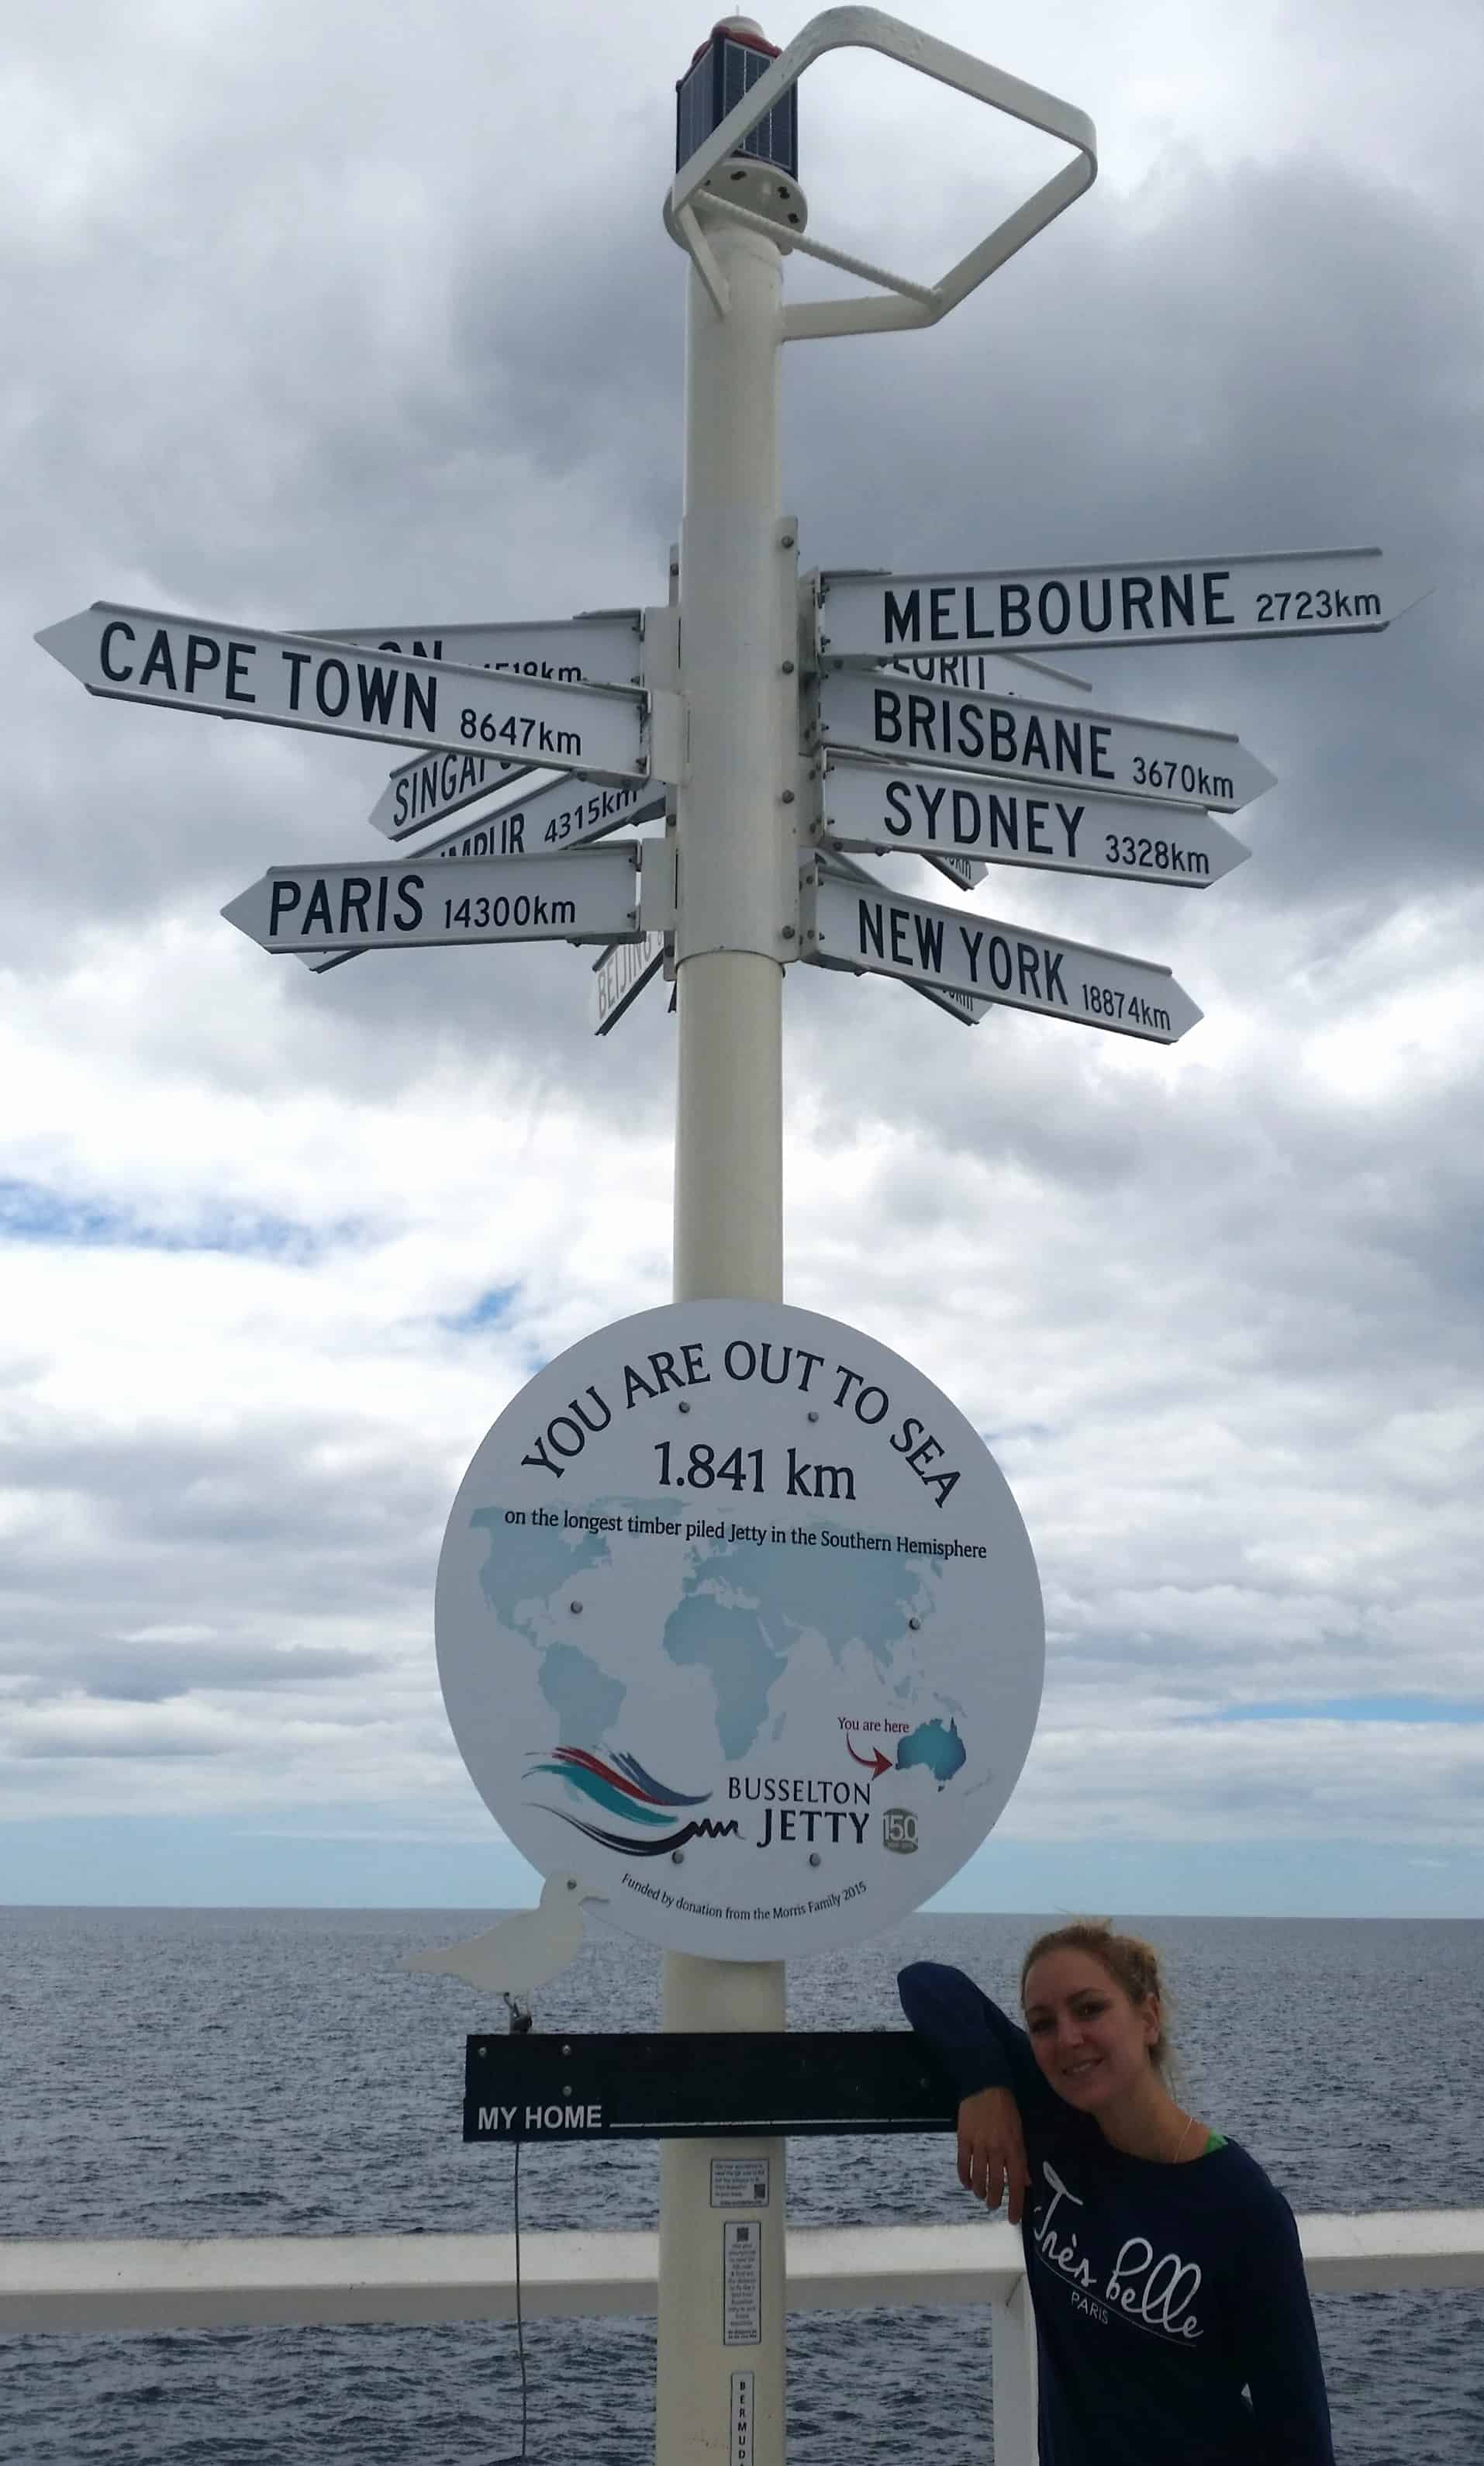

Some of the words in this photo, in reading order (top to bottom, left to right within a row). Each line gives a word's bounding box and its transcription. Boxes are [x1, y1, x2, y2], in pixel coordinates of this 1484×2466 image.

[884, 572, 1235, 644] MELBOURNE
[1255, 592, 1381, 622] 2723km
[99, 621, 257, 701] CAPE
[281, 651, 437, 733] TOWN
[459, 710, 582, 756] 8647km
[873, 689, 1115, 779] BRISBANE
[1132, 758, 1234, 800] 3670km
[884, 781, 1085, 858] SYDNEY
[1105, 836, 1210, 874] 3328km
[269, 874, 425, 935] PARIS
[443, 897, 576, 928] 14300km
[858, 900, 944, 973] NEW
[958, 927, 1069, 1005] YORK
[1082, 984, 1171, 1031] 18874km
[521, 1387, 611, 1477] YOU
[623, 1343, 710, 1408] ARE
[724, 1340, 824, 1391] OUT
[833, 1366, 889, 1425] TO
[889, 1418, 961, 1508] SEA
[654, 1441, 765, 1492] 1.841
[786, 1449, 855, 1500] km
[505, 1510, 526, 1525] on
[531, 1508, 558, 1526] the
[563, 1509, 622, 1533] longest
[627, 1513, 682, 1536] timber
[685, 1519, 725, 1541] piled
[728, 1522, 767, 1546] Jetty
[771, 1525, 786, 1543] in
[791, 1528, 817, 1546] the
[821, 1530, 892, 1551] Southern
[896, 1536, 987, 1561] Hemisphere
[837, 1717, 860, 1731] You
[863, 1721, 881, 1732] are
[884, 1719, 909, 1733] here
[728, 1777, 871, 1805] BUSSELTON
[758, 1808, 869, 1847] JETTY
[882, 1815, 918, 1842] 150
[622, 1873, 658, 1900] Funded
[660, 1894, 675, 1908] by
[675, 1898, 722, 1919] donation
[726, 1908, 751, 1920] from
[753, 1907, 770, 1919] the
[773, 1902, 806, 1919] Morris
[807, 1893, 840, 1915] Family
[843, 1881, 868, 1901] 2015
[478, 2106, 517, 2130] MY
[525, 2105, 602, 2129] HOME
[1034, 2160, 1097, 2286] Très
[1106, 2237, 1204, 2339] belle
[1071, 2292, 1110, 2326] PARIS
[737, 2381, 747, 2466] BERMUD
